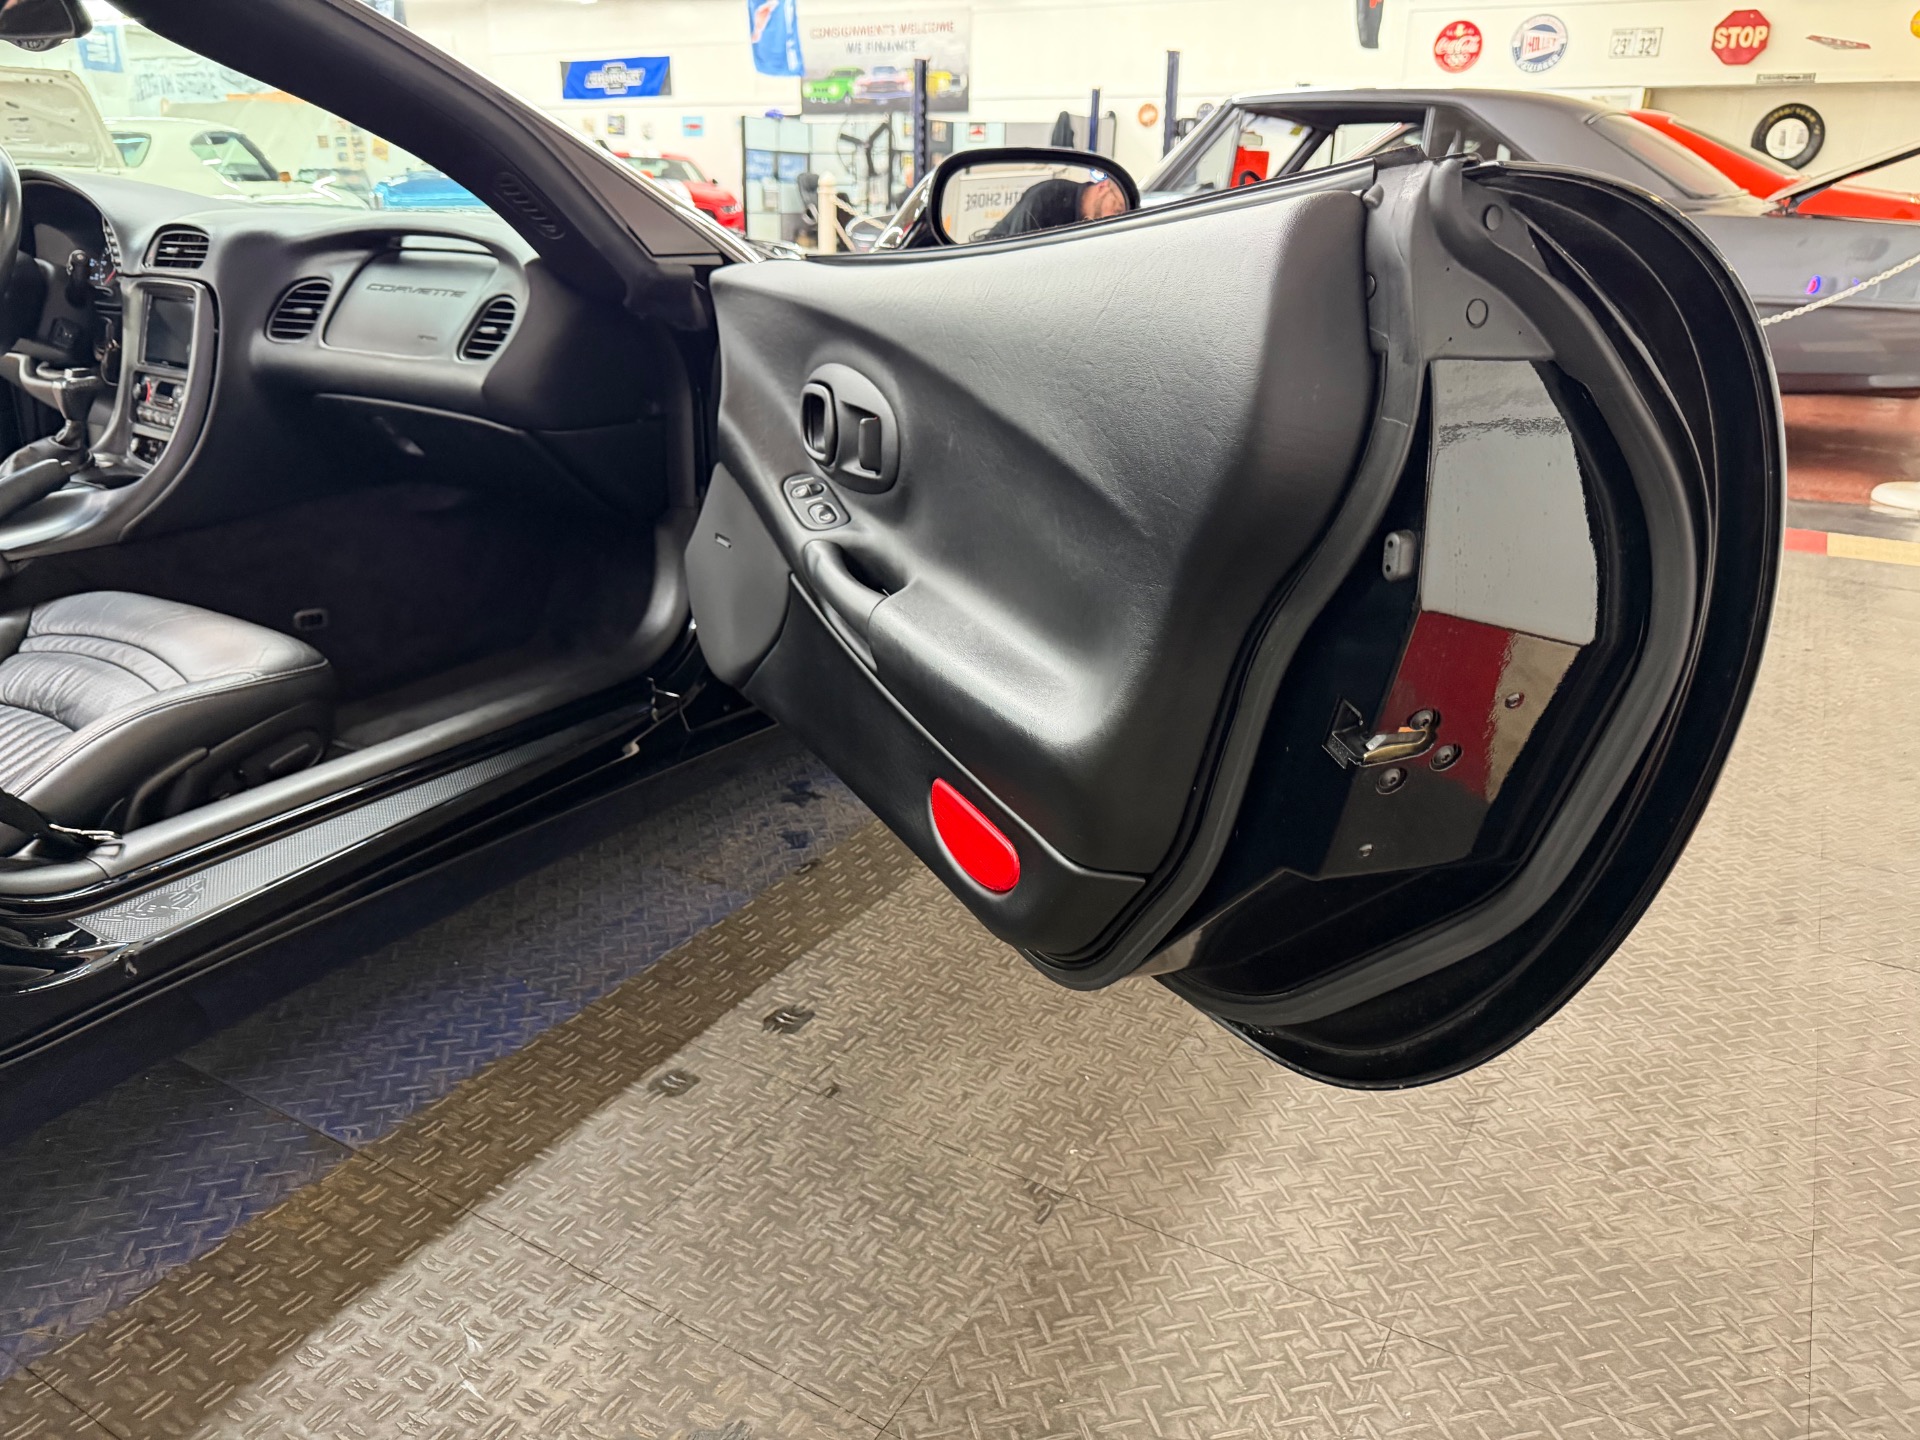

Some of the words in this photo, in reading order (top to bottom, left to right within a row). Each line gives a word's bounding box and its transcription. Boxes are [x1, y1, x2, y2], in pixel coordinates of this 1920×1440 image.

[899, 20, 955, 35] WELCOME
[1714, 25, 1768, 49] STOP
[846, 41, 861, 54] WE
[865, 39, 917, 53] FINANCE
[366, 283, 467, 298] CORVETTE
